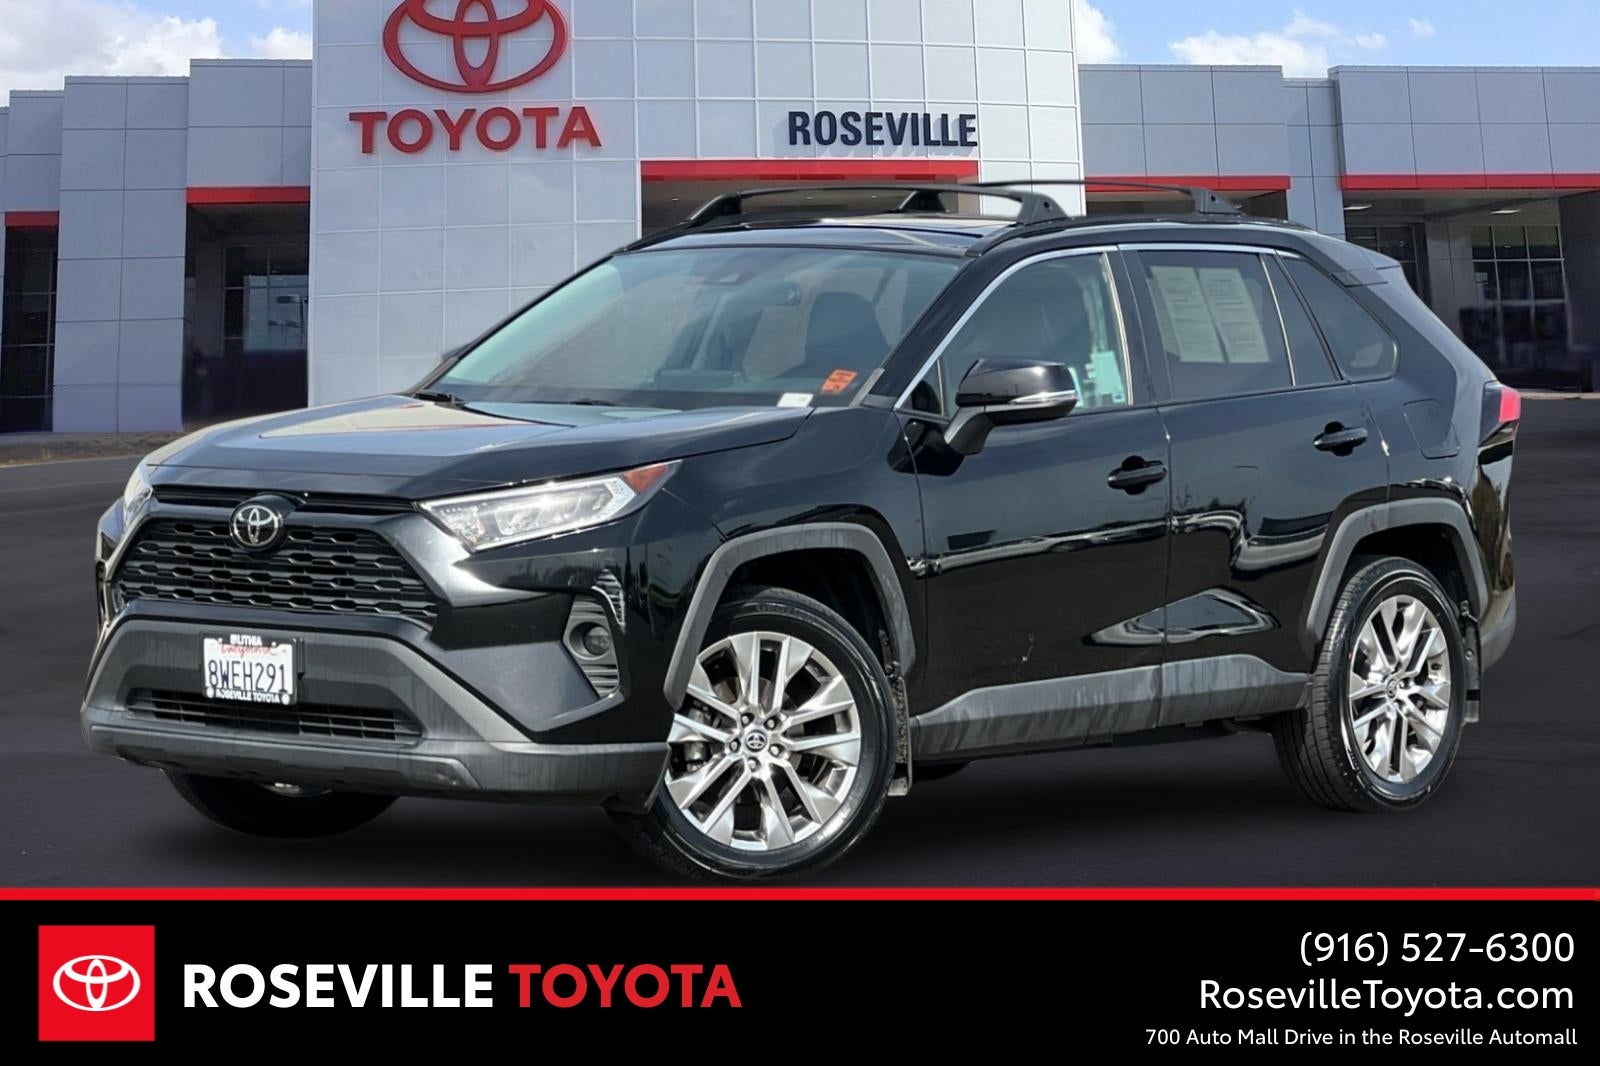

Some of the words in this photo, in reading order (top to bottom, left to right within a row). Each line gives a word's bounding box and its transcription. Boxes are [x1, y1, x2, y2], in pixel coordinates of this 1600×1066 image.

[350, 106, 602, 154] TOYOTA
[788, 110, 979, 147] ROSEVILLE
[208, 659, 288, 693] 8WEH291
[253, 692, 280, 703] TOYOTA
